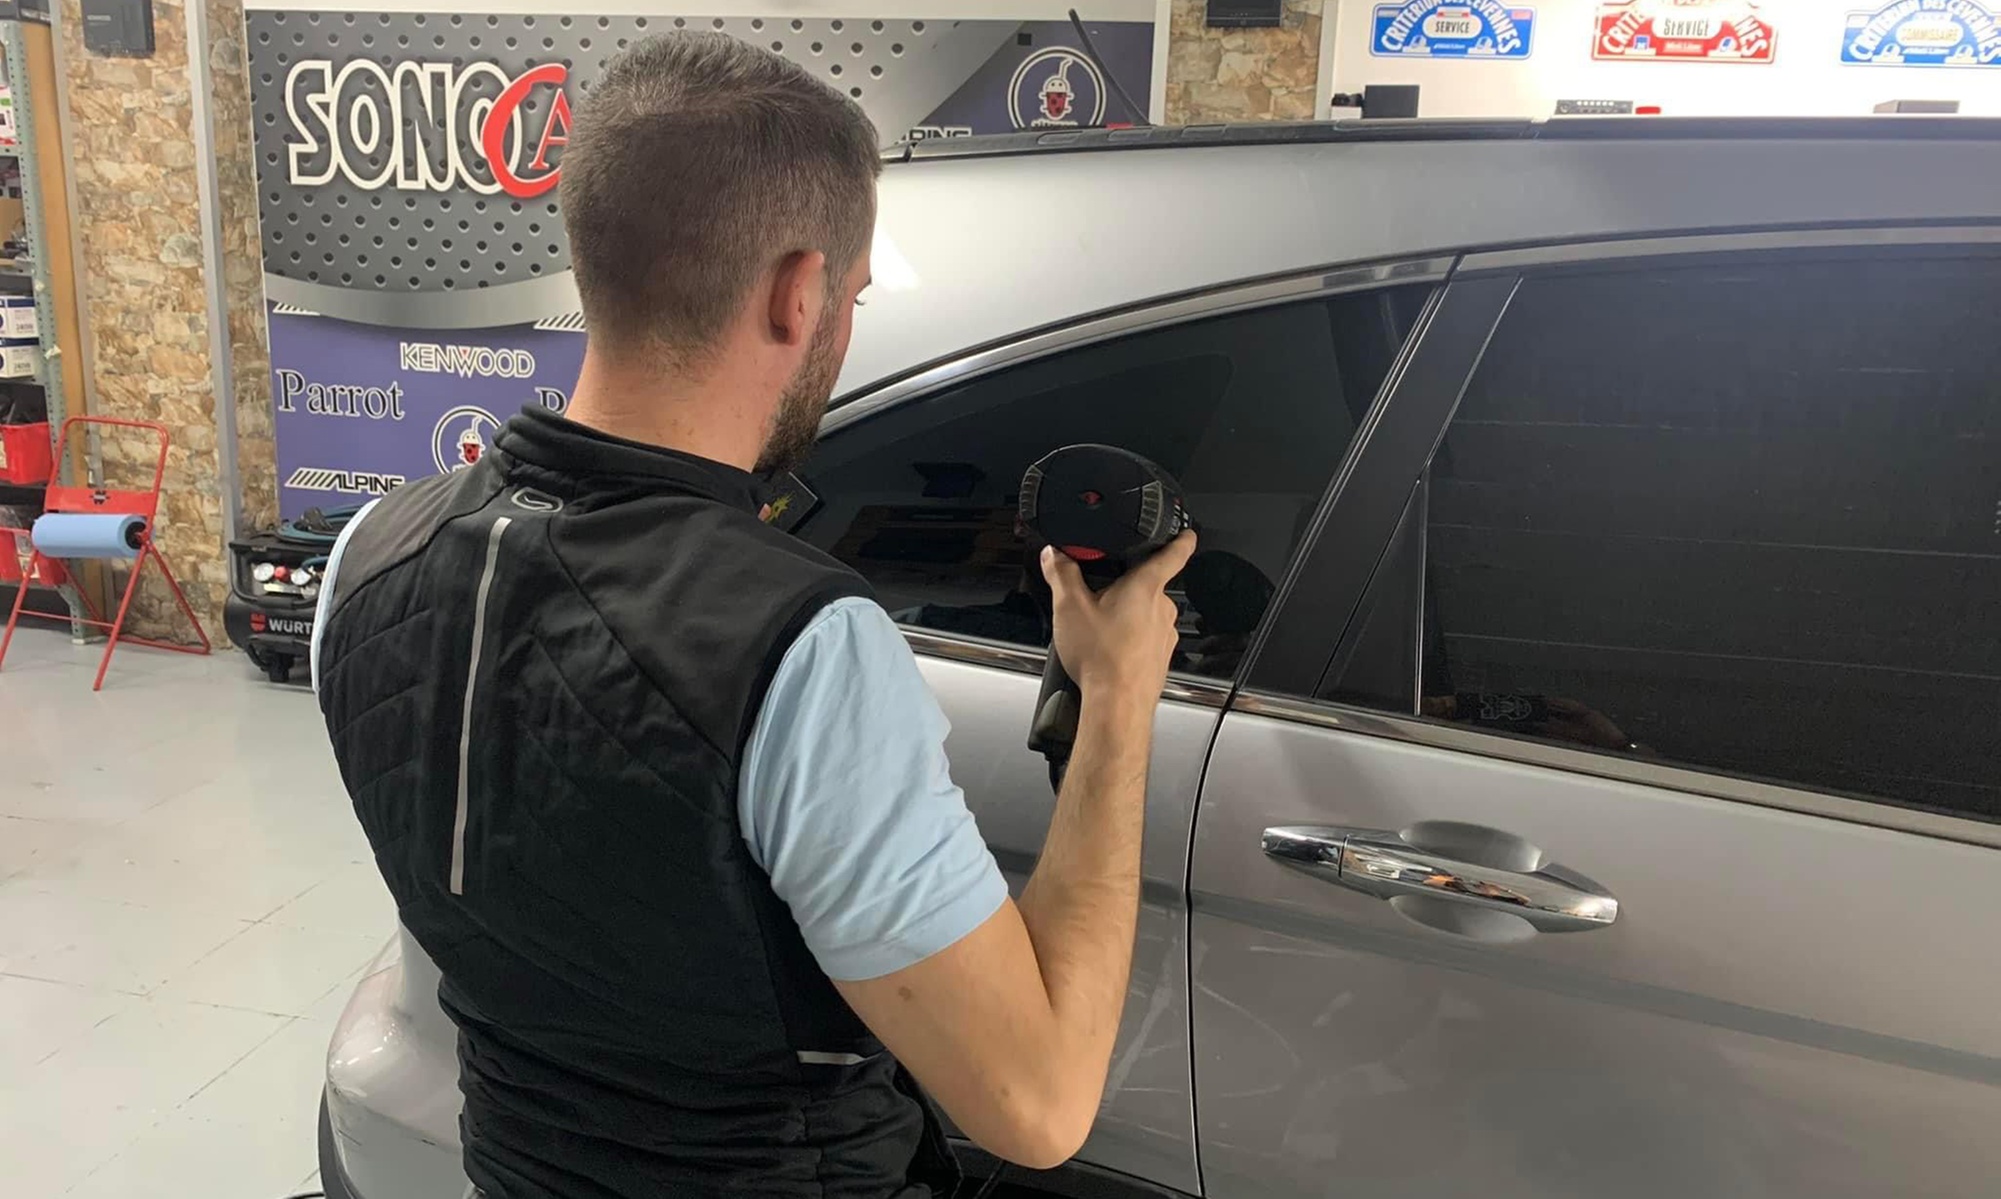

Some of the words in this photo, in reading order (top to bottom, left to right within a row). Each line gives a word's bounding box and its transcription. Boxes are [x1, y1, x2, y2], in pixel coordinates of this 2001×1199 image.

[1435, 20, 1470, 33] SERVICE
[285, 58, 573, 198] SONOCA
[399, 342, 535, 378] KENWOOD
[276, 369, 405, 419] Parrot
[269, 619, 313, 635] WÜRT
